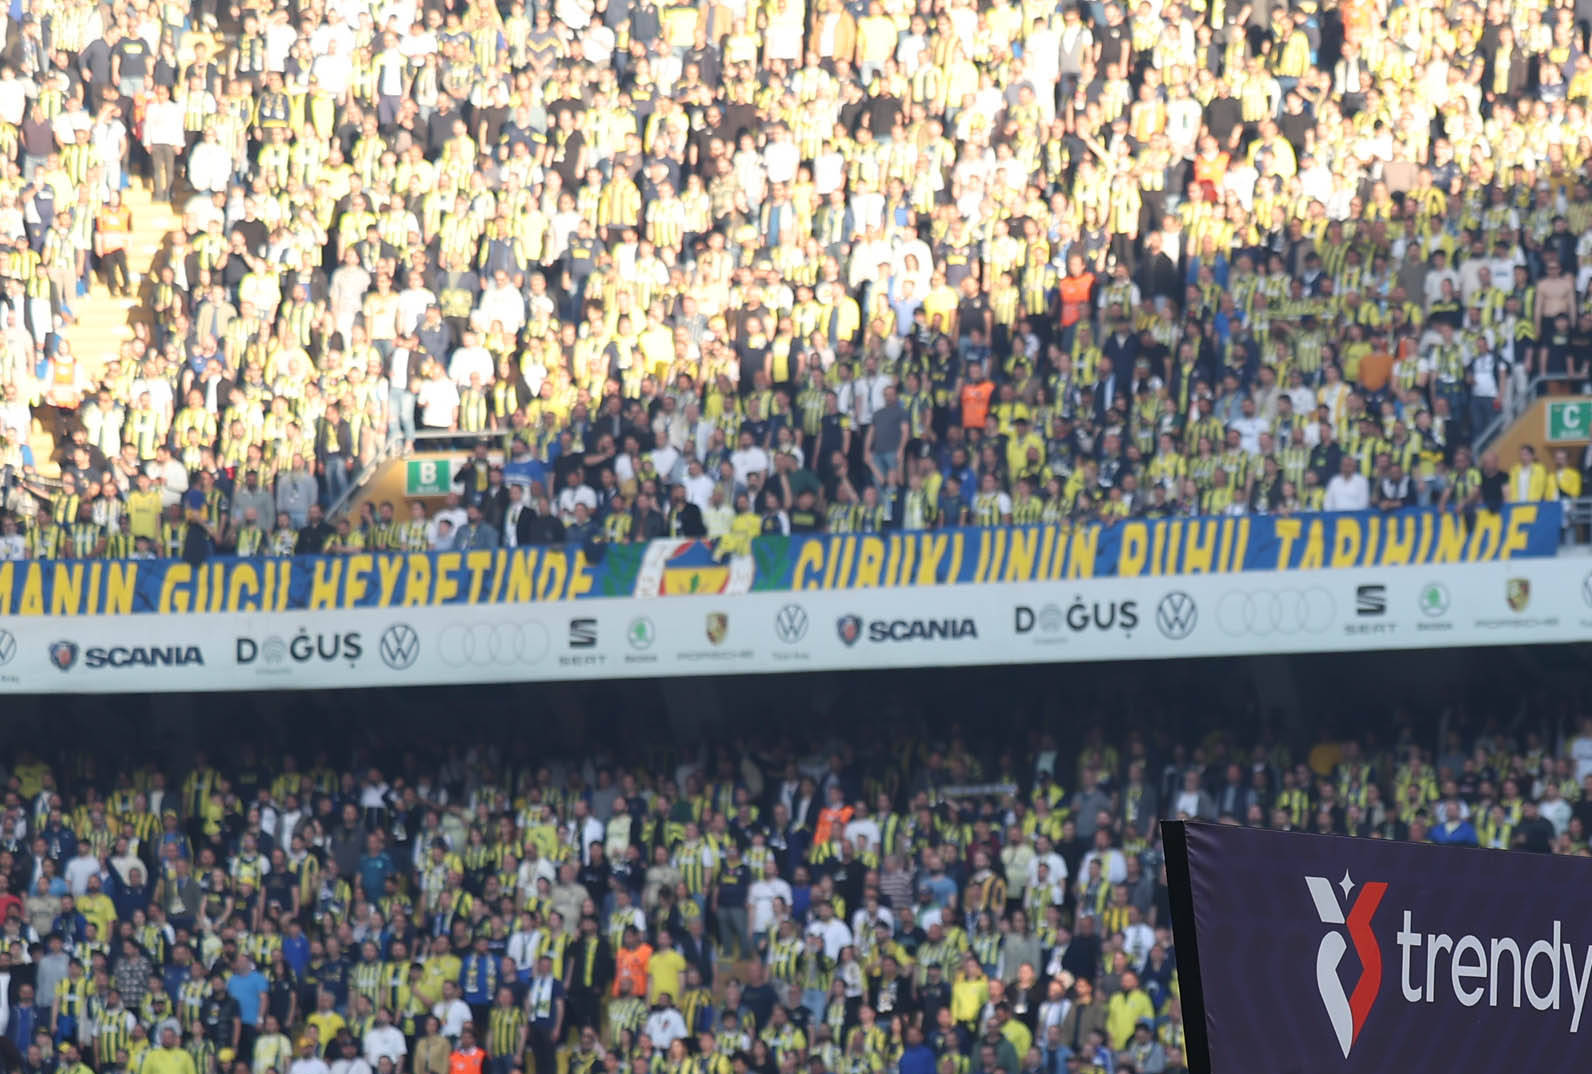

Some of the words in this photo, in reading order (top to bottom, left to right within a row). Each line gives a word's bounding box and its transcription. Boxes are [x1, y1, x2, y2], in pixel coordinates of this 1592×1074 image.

[1562, 404, 1581, 431] C
[420, 461, 437, 484] B
[869, 618, 979, 643] SCANIA
[85, 645, 205, 669] SCANIA
